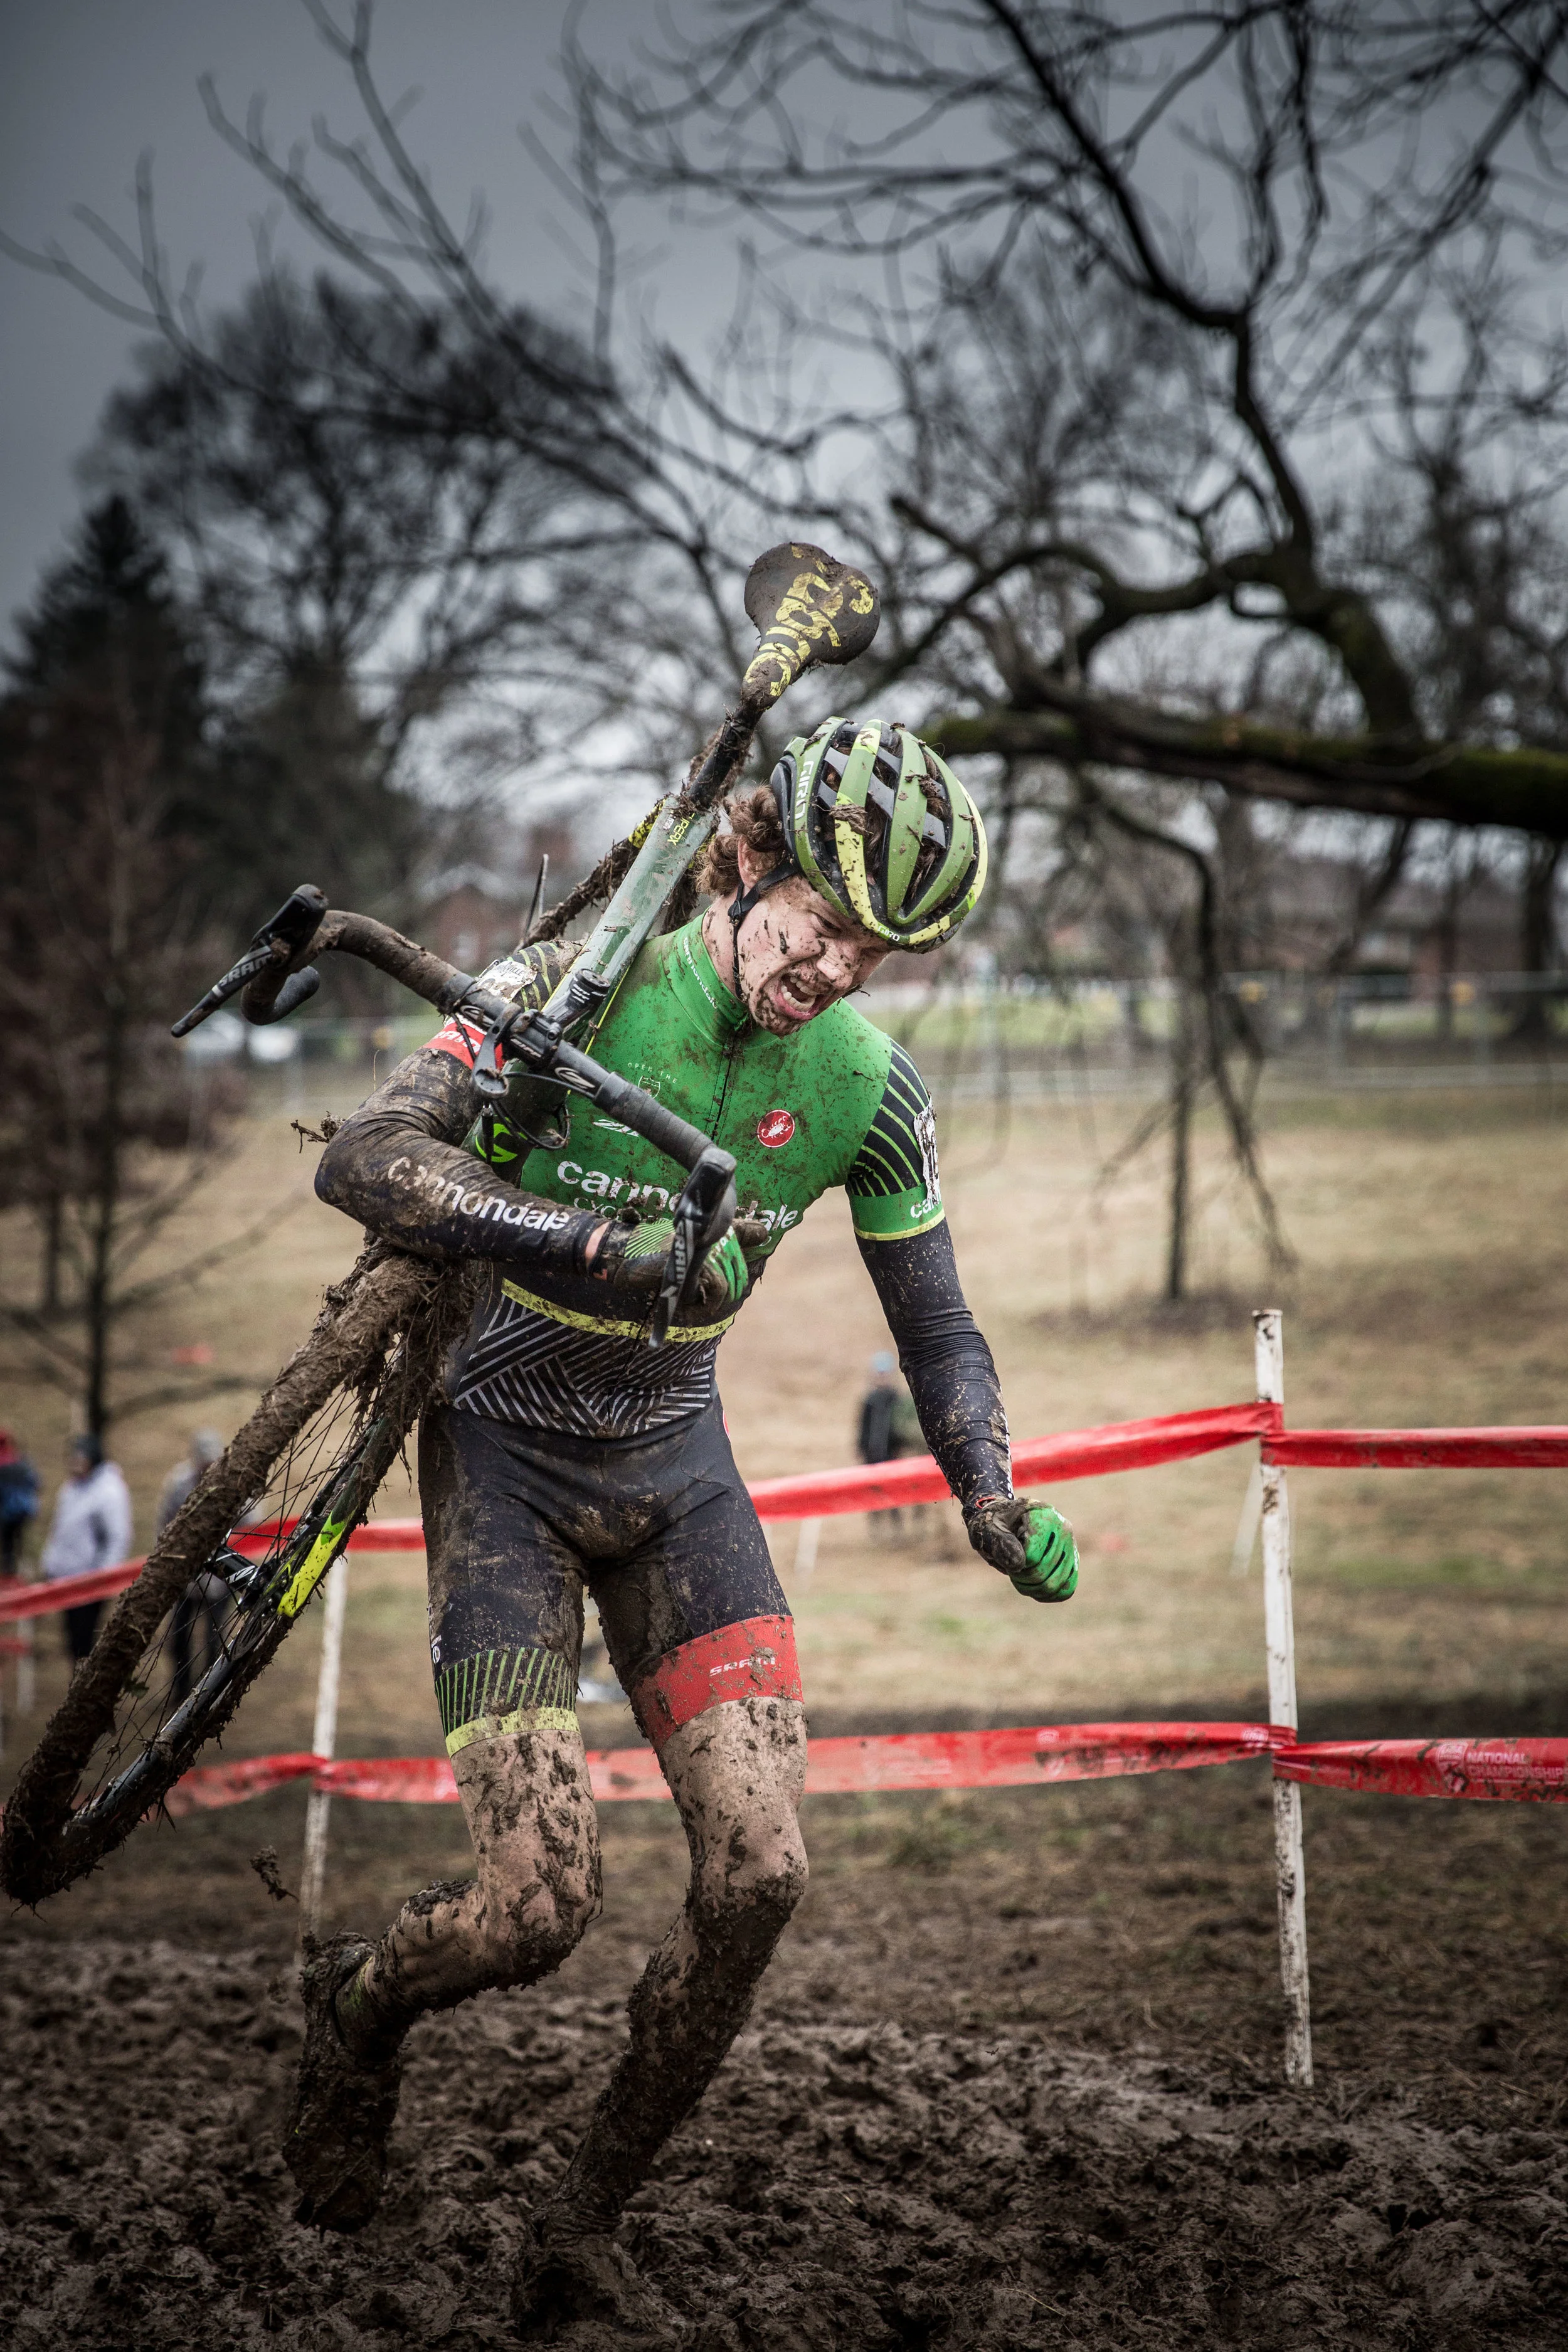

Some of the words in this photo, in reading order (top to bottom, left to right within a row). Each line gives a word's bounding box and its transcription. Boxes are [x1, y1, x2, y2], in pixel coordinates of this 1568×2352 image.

[795, 760, 814, 819] GIRO
[667, 813, 695, 845] PERX
[877, 925, 900, 941] GIRO
[628, 1062, 653, 1072] OPEN
[659, 1071, 677, 1084] THE
[1466, 1751, 1528, 1764] NATIONAL
